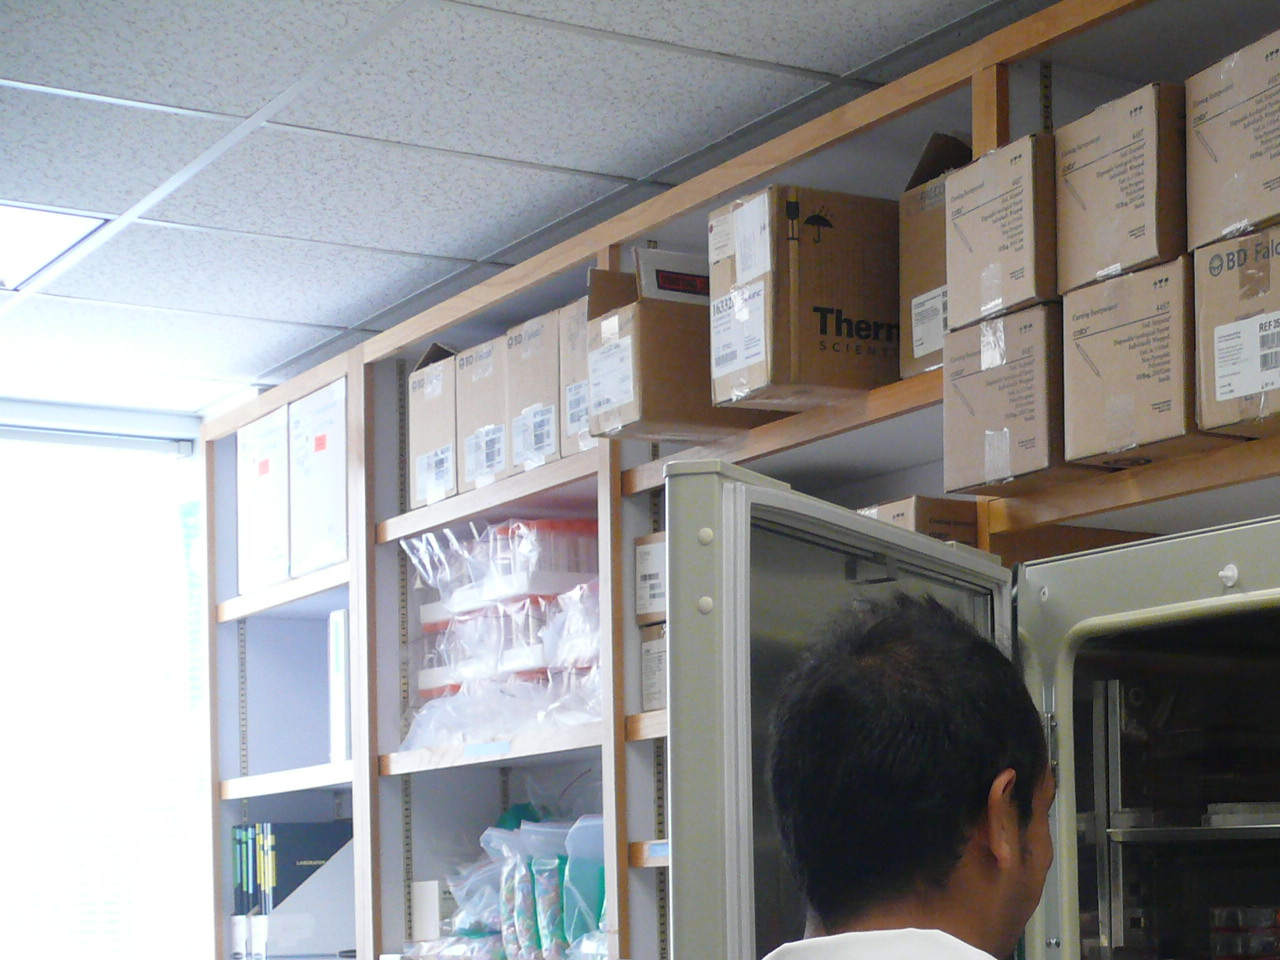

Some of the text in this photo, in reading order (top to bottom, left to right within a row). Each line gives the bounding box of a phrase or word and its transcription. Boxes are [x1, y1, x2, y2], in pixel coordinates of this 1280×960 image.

[1226, 249, 1247, 271] BD
[713, 297, 734, 316] 16332
[1259, 321, 1272, 333] REF
